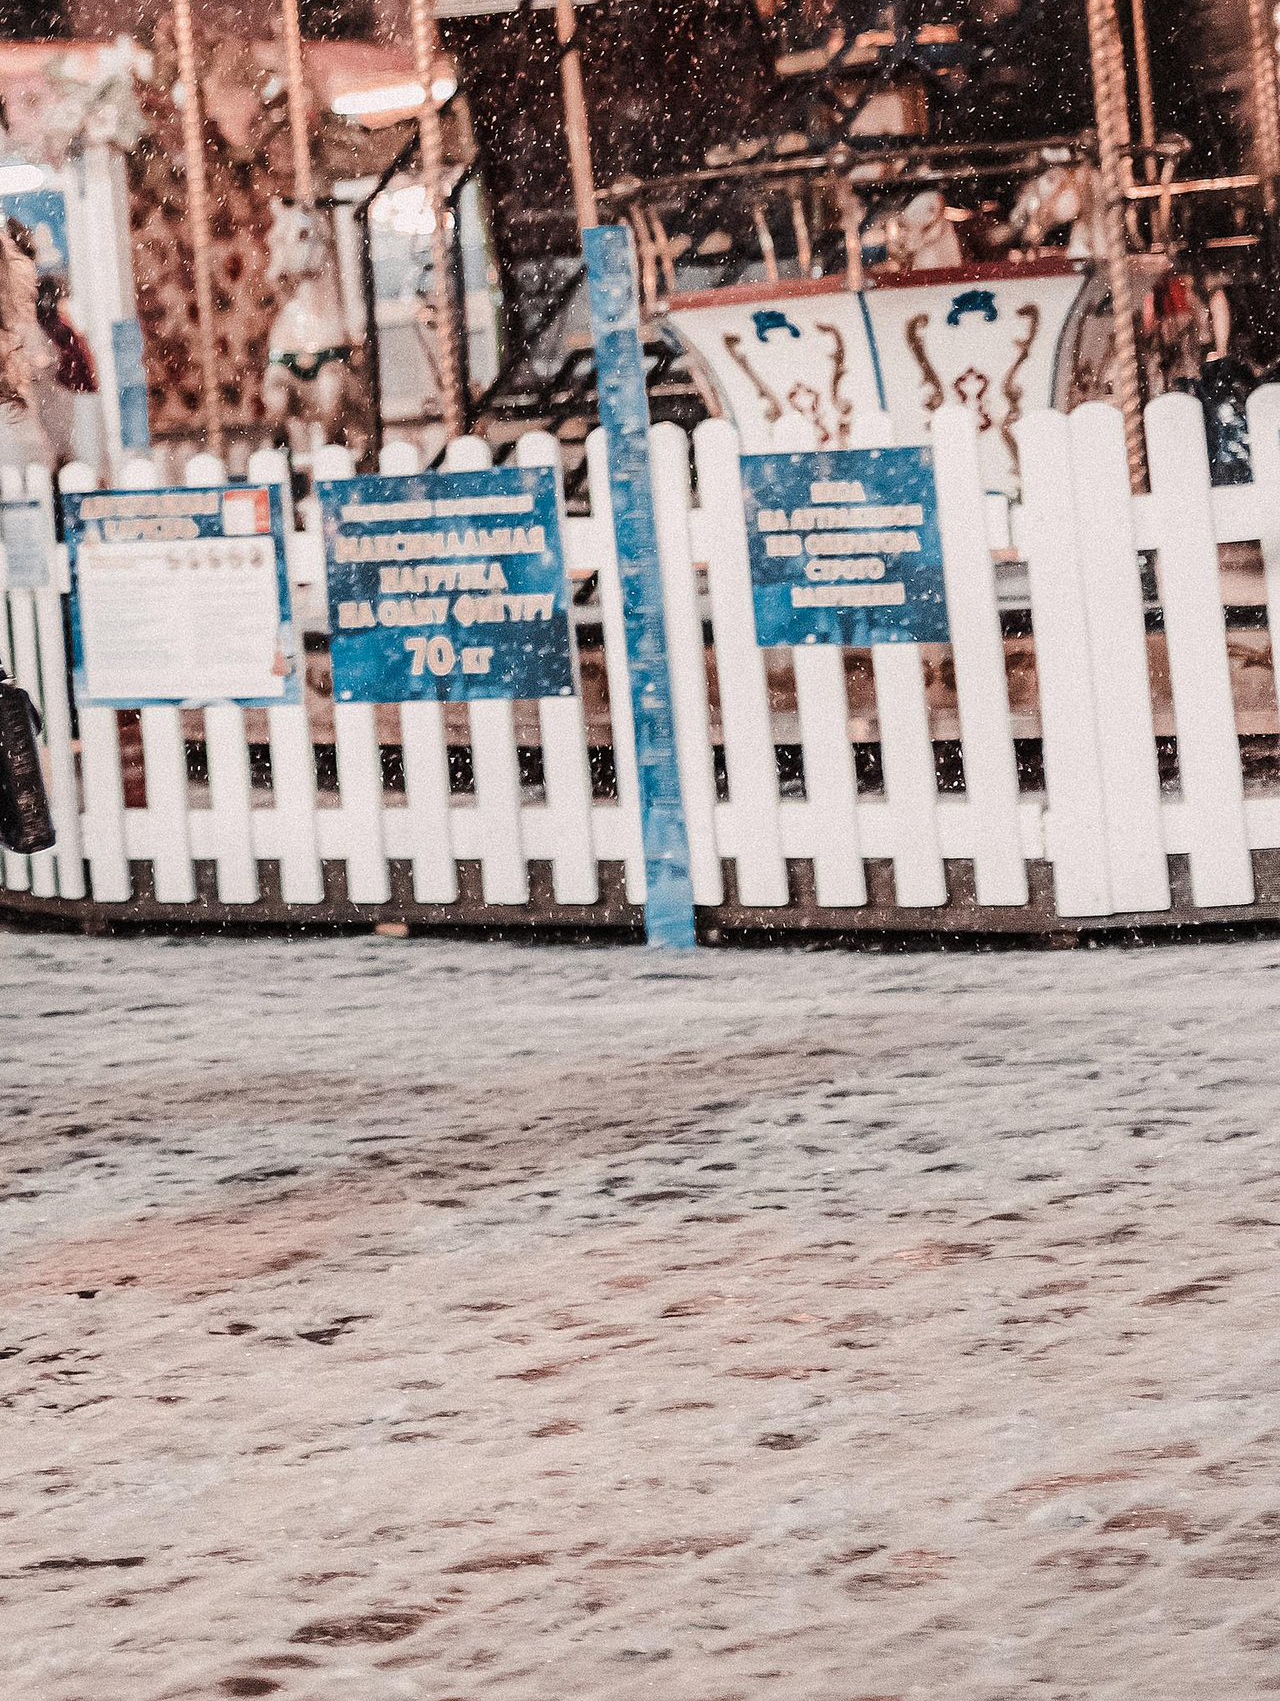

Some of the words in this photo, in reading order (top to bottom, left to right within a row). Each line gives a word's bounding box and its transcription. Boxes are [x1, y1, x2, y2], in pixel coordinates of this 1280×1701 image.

[336, 526, 545, 564] МАКСИМАЛЬНАЯ
[379, 563, 508, 593] НАГРУЗКА
[338, 602, 376, 628] НА
[377, 597, 449, 627] ОДНУ
[454, 594, 555, 627] ФИГУРУ
[404, 636, 456, 676] 70
